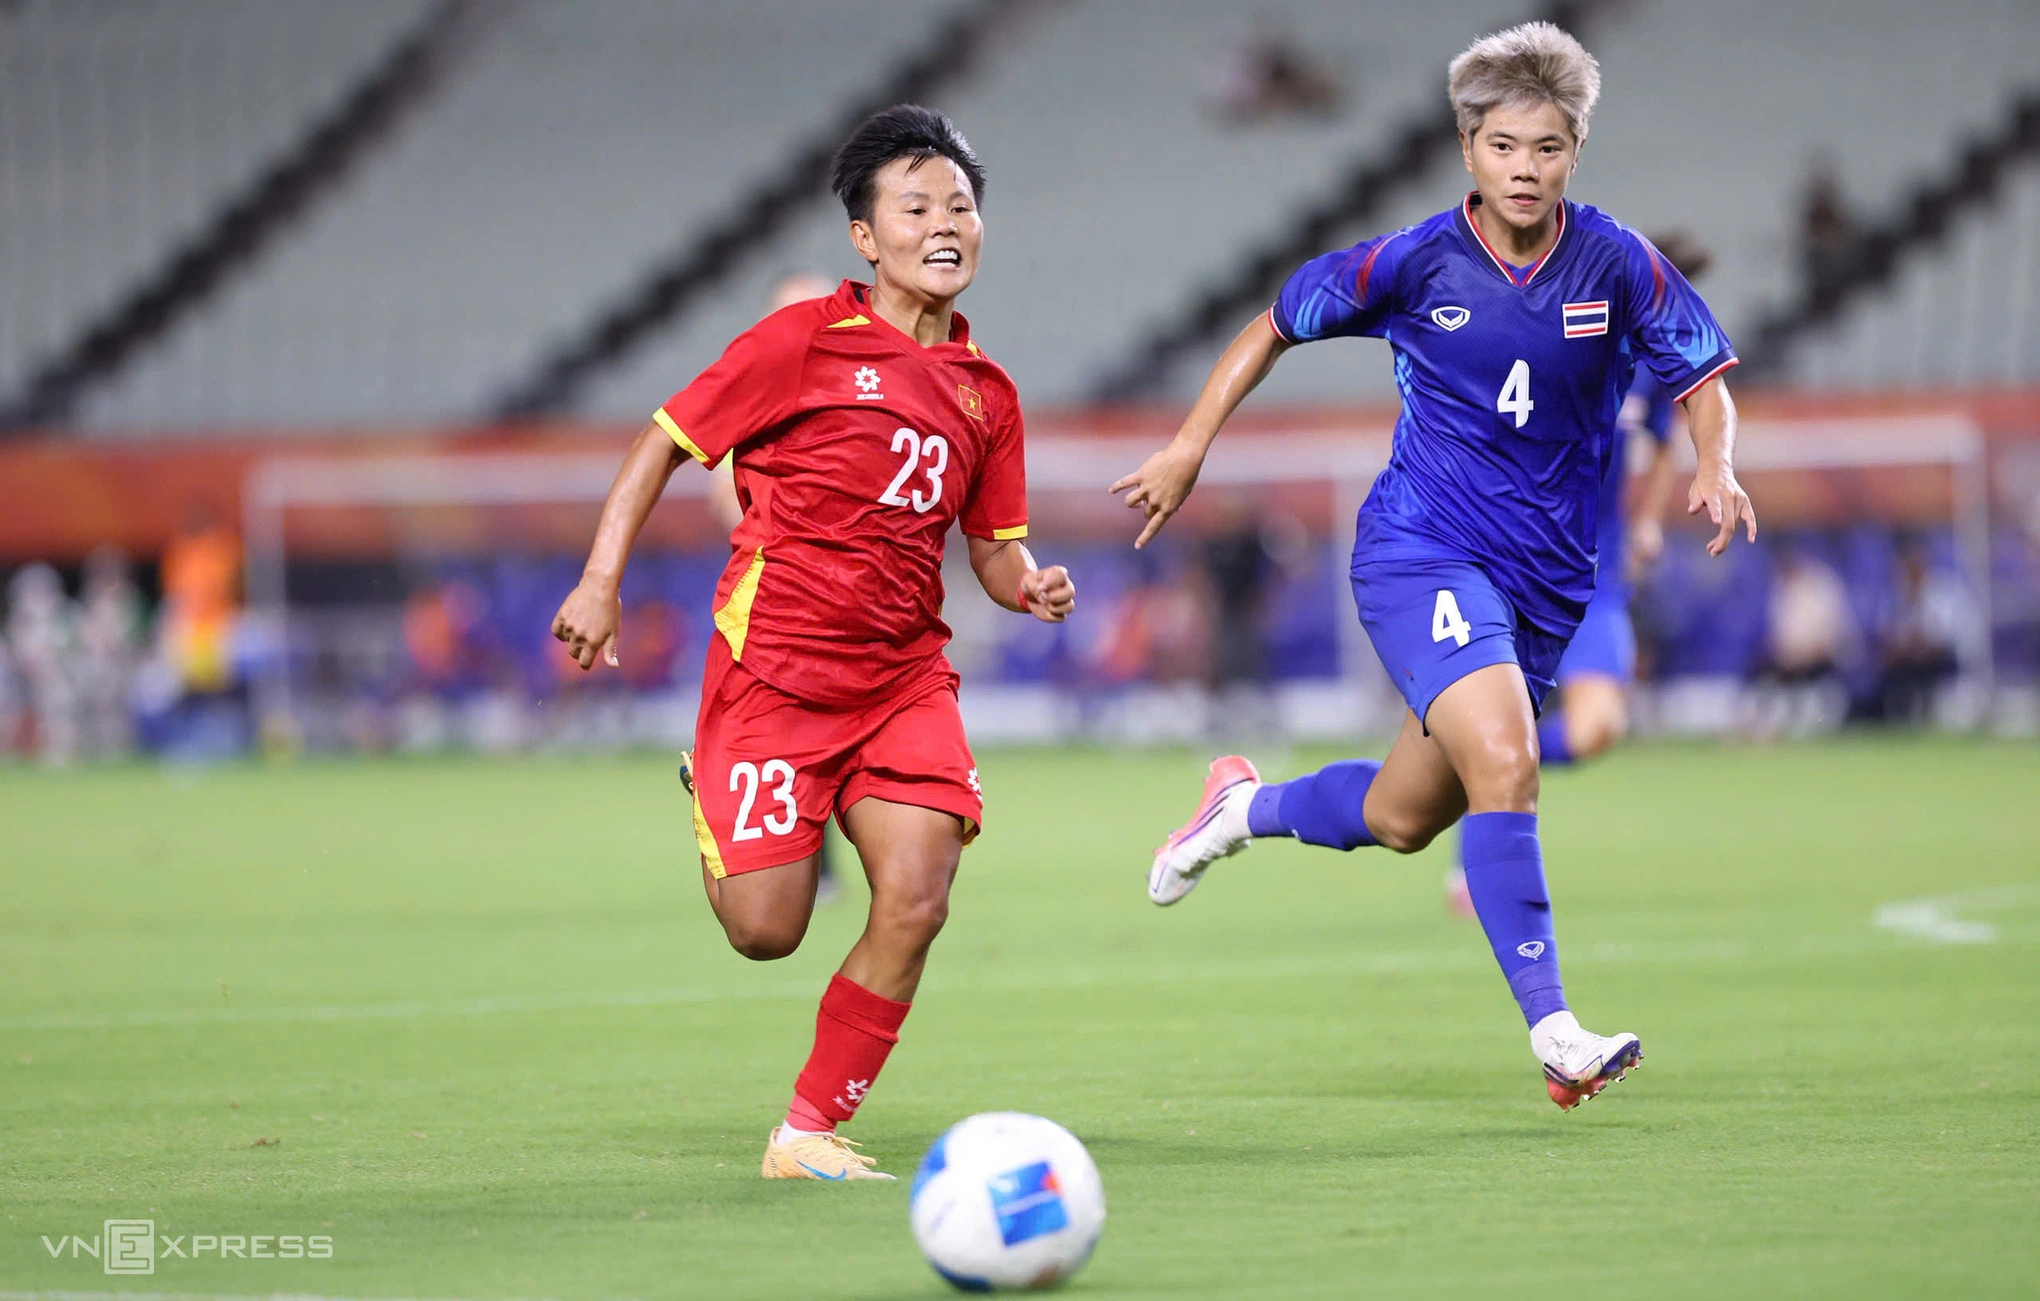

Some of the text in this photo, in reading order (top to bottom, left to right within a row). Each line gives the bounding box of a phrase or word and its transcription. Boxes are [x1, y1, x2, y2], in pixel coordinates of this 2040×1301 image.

[1497, 359, 1534, 428] 4
[878, 427, 949, 513] 23
[1432, 589, 1471, 647] 4
[730, 759, 798, 842] 23
